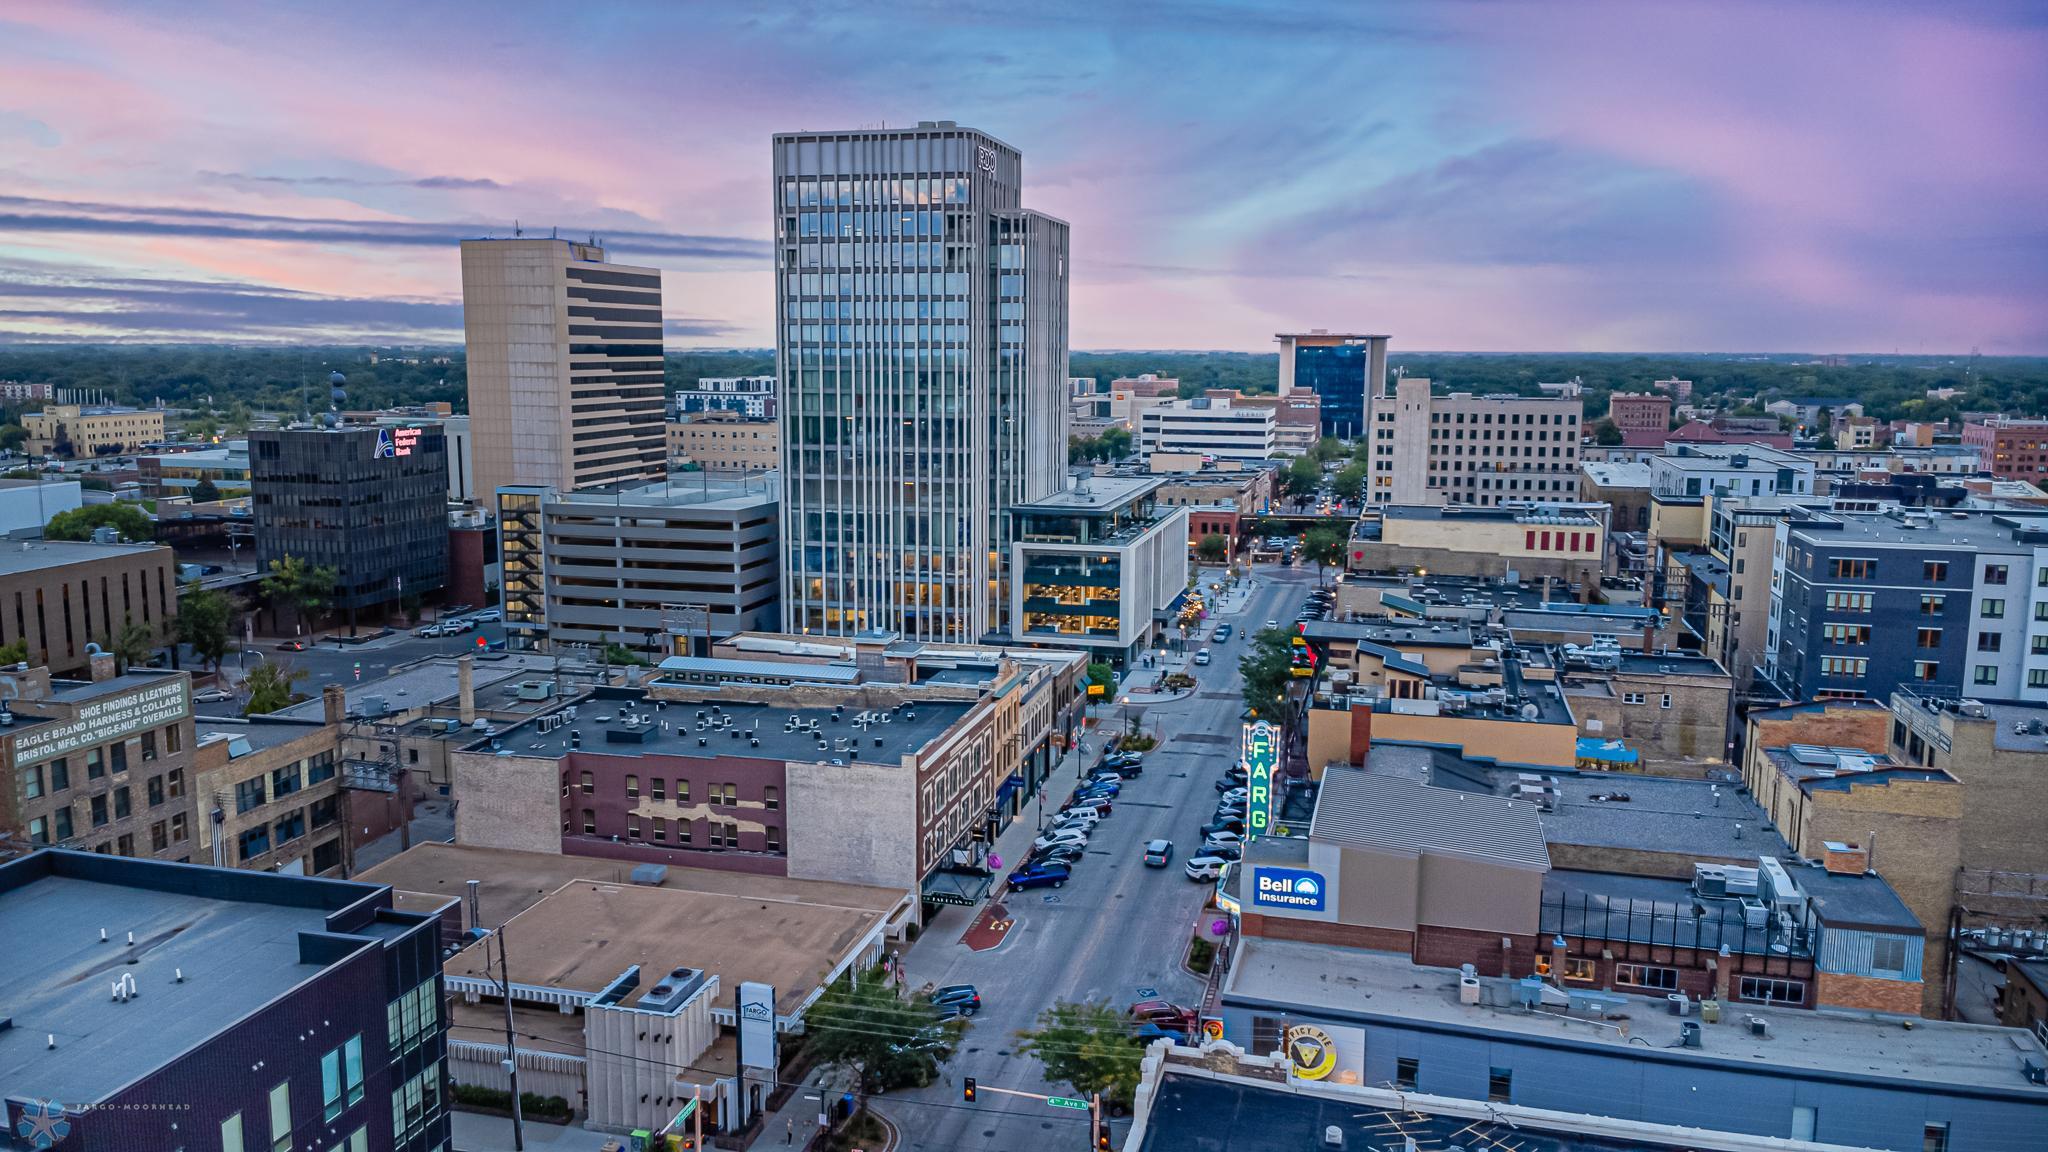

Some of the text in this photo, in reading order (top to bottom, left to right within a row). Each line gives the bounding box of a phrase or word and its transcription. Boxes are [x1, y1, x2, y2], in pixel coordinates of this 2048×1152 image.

[395, 428, 422, 437] American
[395, 437, 417, 446] Federal
[395, 447, 411, 456] Bank
[80, 682, 182, 719] SHOE FINDINGS & LEATHERS
[16, 695, 182, 749] EAGLE BRAND HARNESS & COLLARS
[17, 744, 56, 762] BRISTOL
[57, 737, 79, 750] MFG.
[81, 732, 96, 743] CO.
[143, 705, 183, 725] OVERALLS
[1252, 741, 1269, 842] FARG
[1259, 876, 1292, 893] Bell
[1259, 892, 1318, 906] Insurance
[1316, 1032, 1332, 1047] PIE
